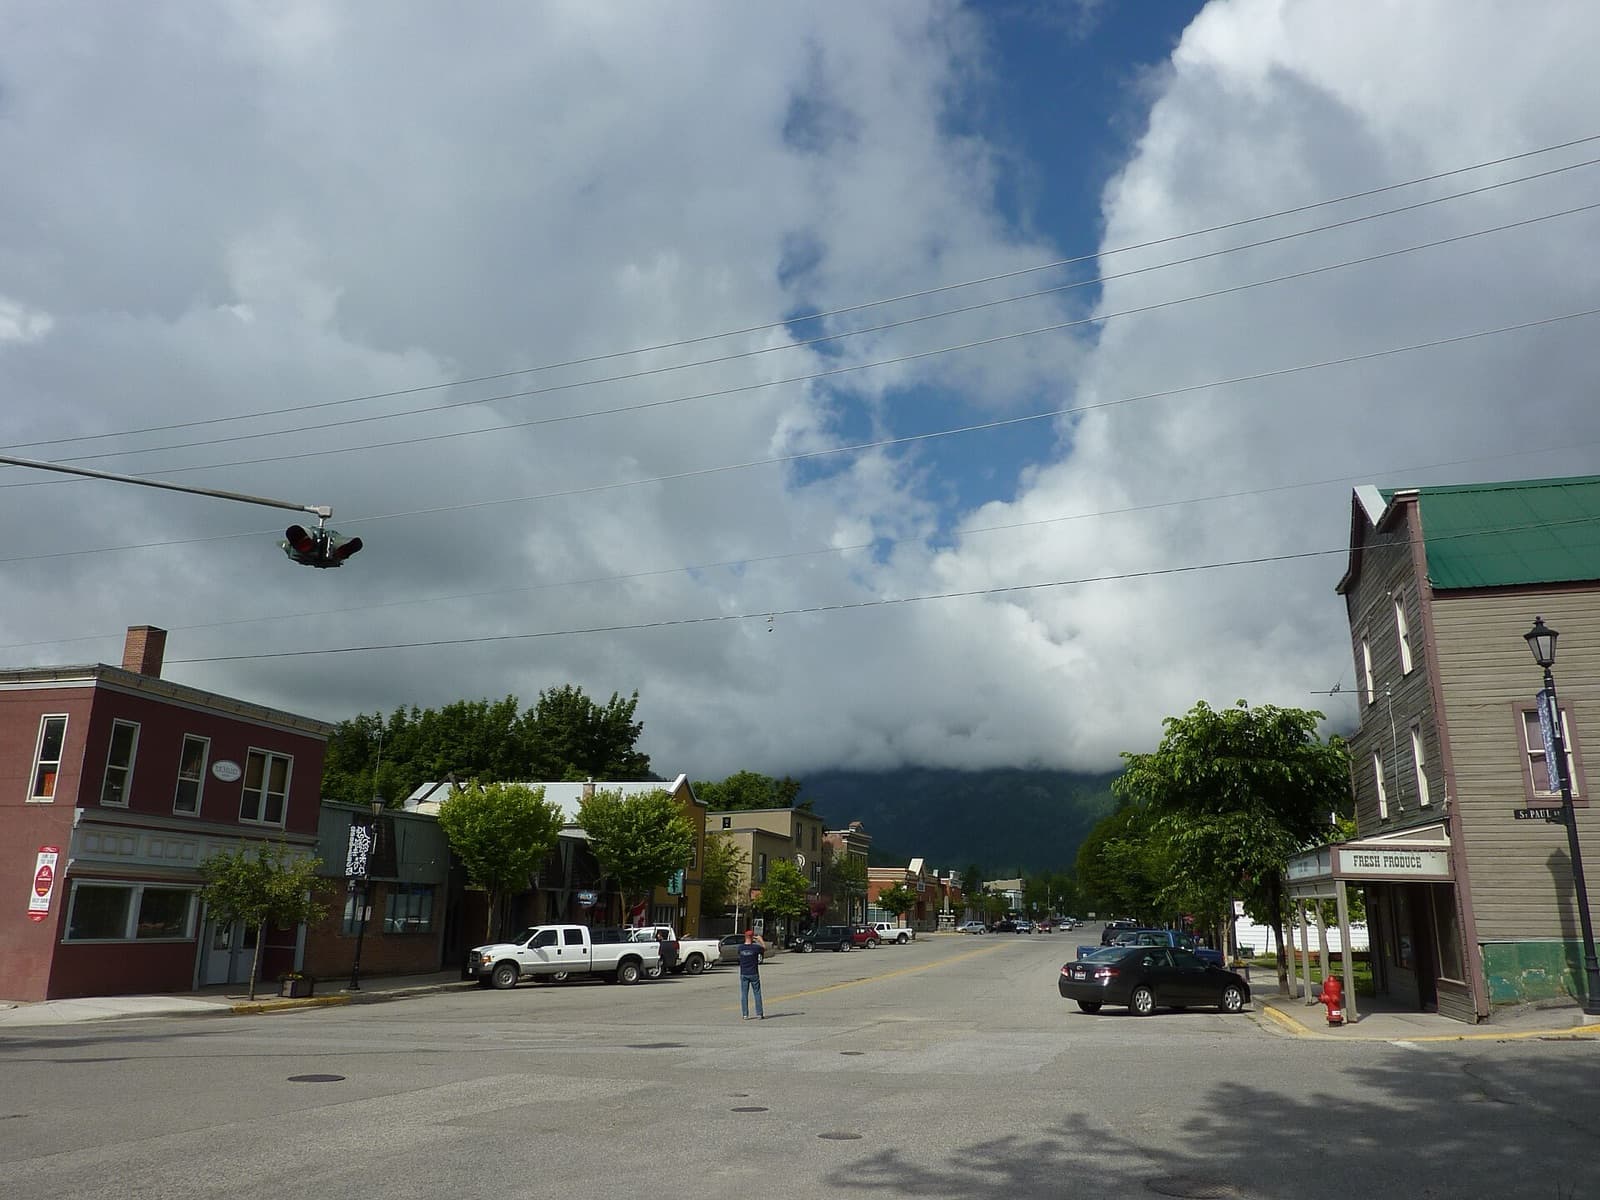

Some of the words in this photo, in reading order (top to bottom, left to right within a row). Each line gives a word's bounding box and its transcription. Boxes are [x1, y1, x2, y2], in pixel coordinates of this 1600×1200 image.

[1529, 809, 1552, 819] PAUL
[1353, 855, 1381, 868] FRESH
[1383, 855, 1422, 869] PRODUCE
